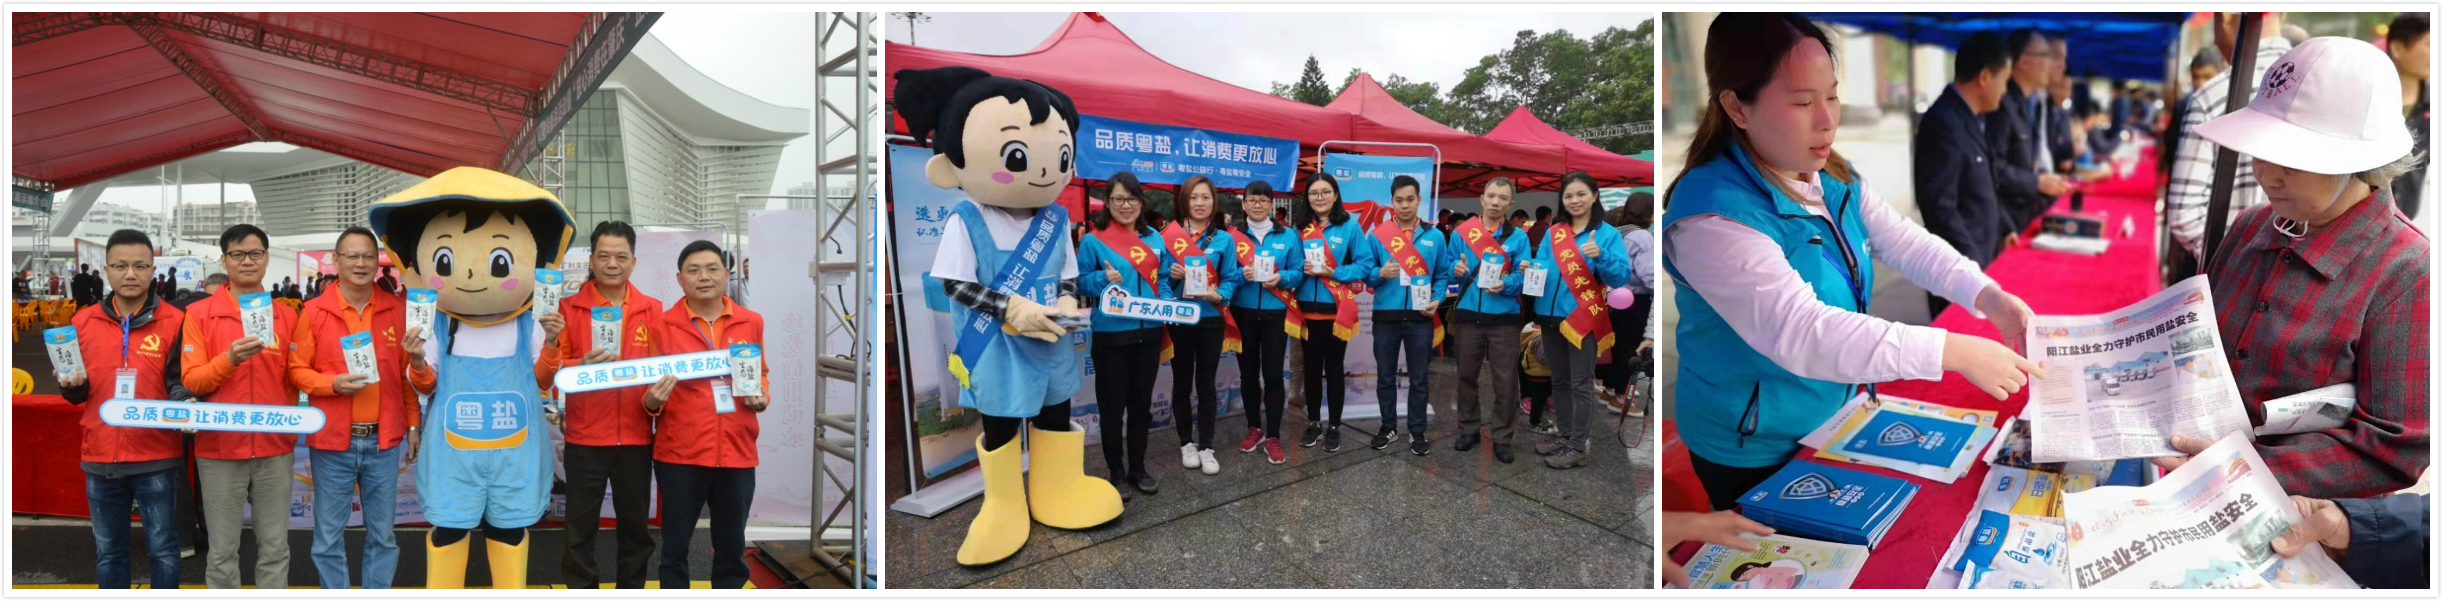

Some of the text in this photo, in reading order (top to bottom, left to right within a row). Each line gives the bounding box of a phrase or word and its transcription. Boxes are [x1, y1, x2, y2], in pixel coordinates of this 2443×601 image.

[1022, 219, 1055, 265] 品质粤盐
[1559, 248, 1603, 317] 党员先锋队
[1128, 301, 1173, 317] 广东人用
[2046, 310, 2199, 357] 阳江盐业全力守护市民用盐安全
[576, 355, 731, 385] 品质 粤盐 让消费更放心
[122, 406, 303, 427] 品质 粤盐 让消费更放心
[455, 400, 519, 431] 粤盐
[2076, 492, 2258, 589] 阳江盐业全力守护市民用盐安全
